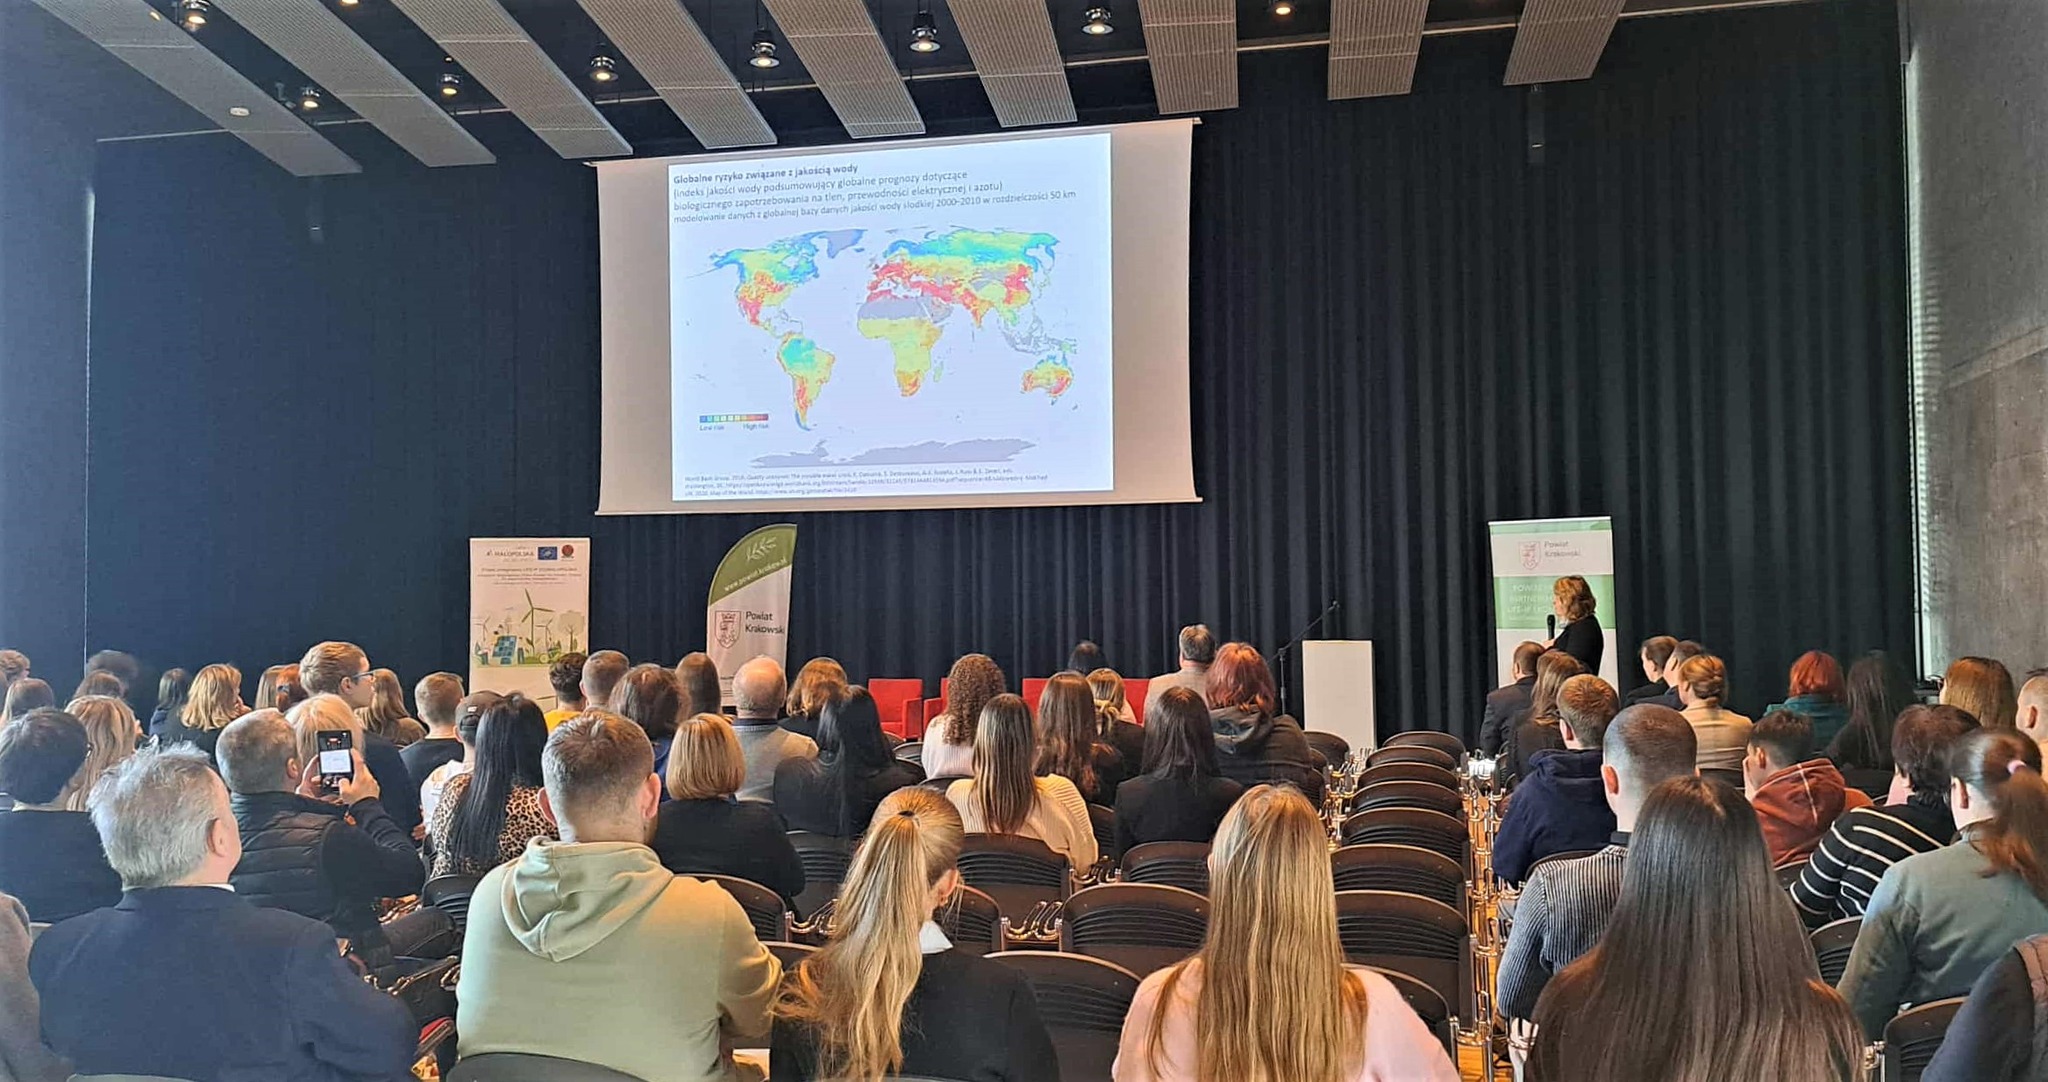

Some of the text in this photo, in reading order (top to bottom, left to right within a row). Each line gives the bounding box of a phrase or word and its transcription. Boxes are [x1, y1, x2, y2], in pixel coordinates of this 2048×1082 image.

[674, 173, 712, 184] Globalne
[715, 172, 743, 182] ryzyko
[746, 169, 786, 180] związane
[795, 165, 830, 178] jakością
[833, 165, 858, 175] wody
[706, 184, 735, 197] jakości
[738, 183, 761, 194] wody
[764, 179, 835, 193] podsumowujący
[838, 176, 876, 189] globalne
[879, 172, 919, 185] prognozy
[923, 171, 968, 182] dotyczące
[674, 200, 732, 213] biologicznego
[735, 195, 809, 209] zapotrzebowania
[848, 188, 909, 201] przewodności
[912, 183, 966, 197] elektrycznej
[974, 182, 1003, 192] azotu)
[728, 210, 755, 221] danych
[763, 207, 798, 219] globalnej
[801, 207, 818, 217] bazy
[821, 205, 848, 215] danych
[880, 203, 901, 212] wody
[1050, 191, 1061, 200] 50
[1063, 190, 1076, 198] km
[746, 611, 773, 620] Powiat
